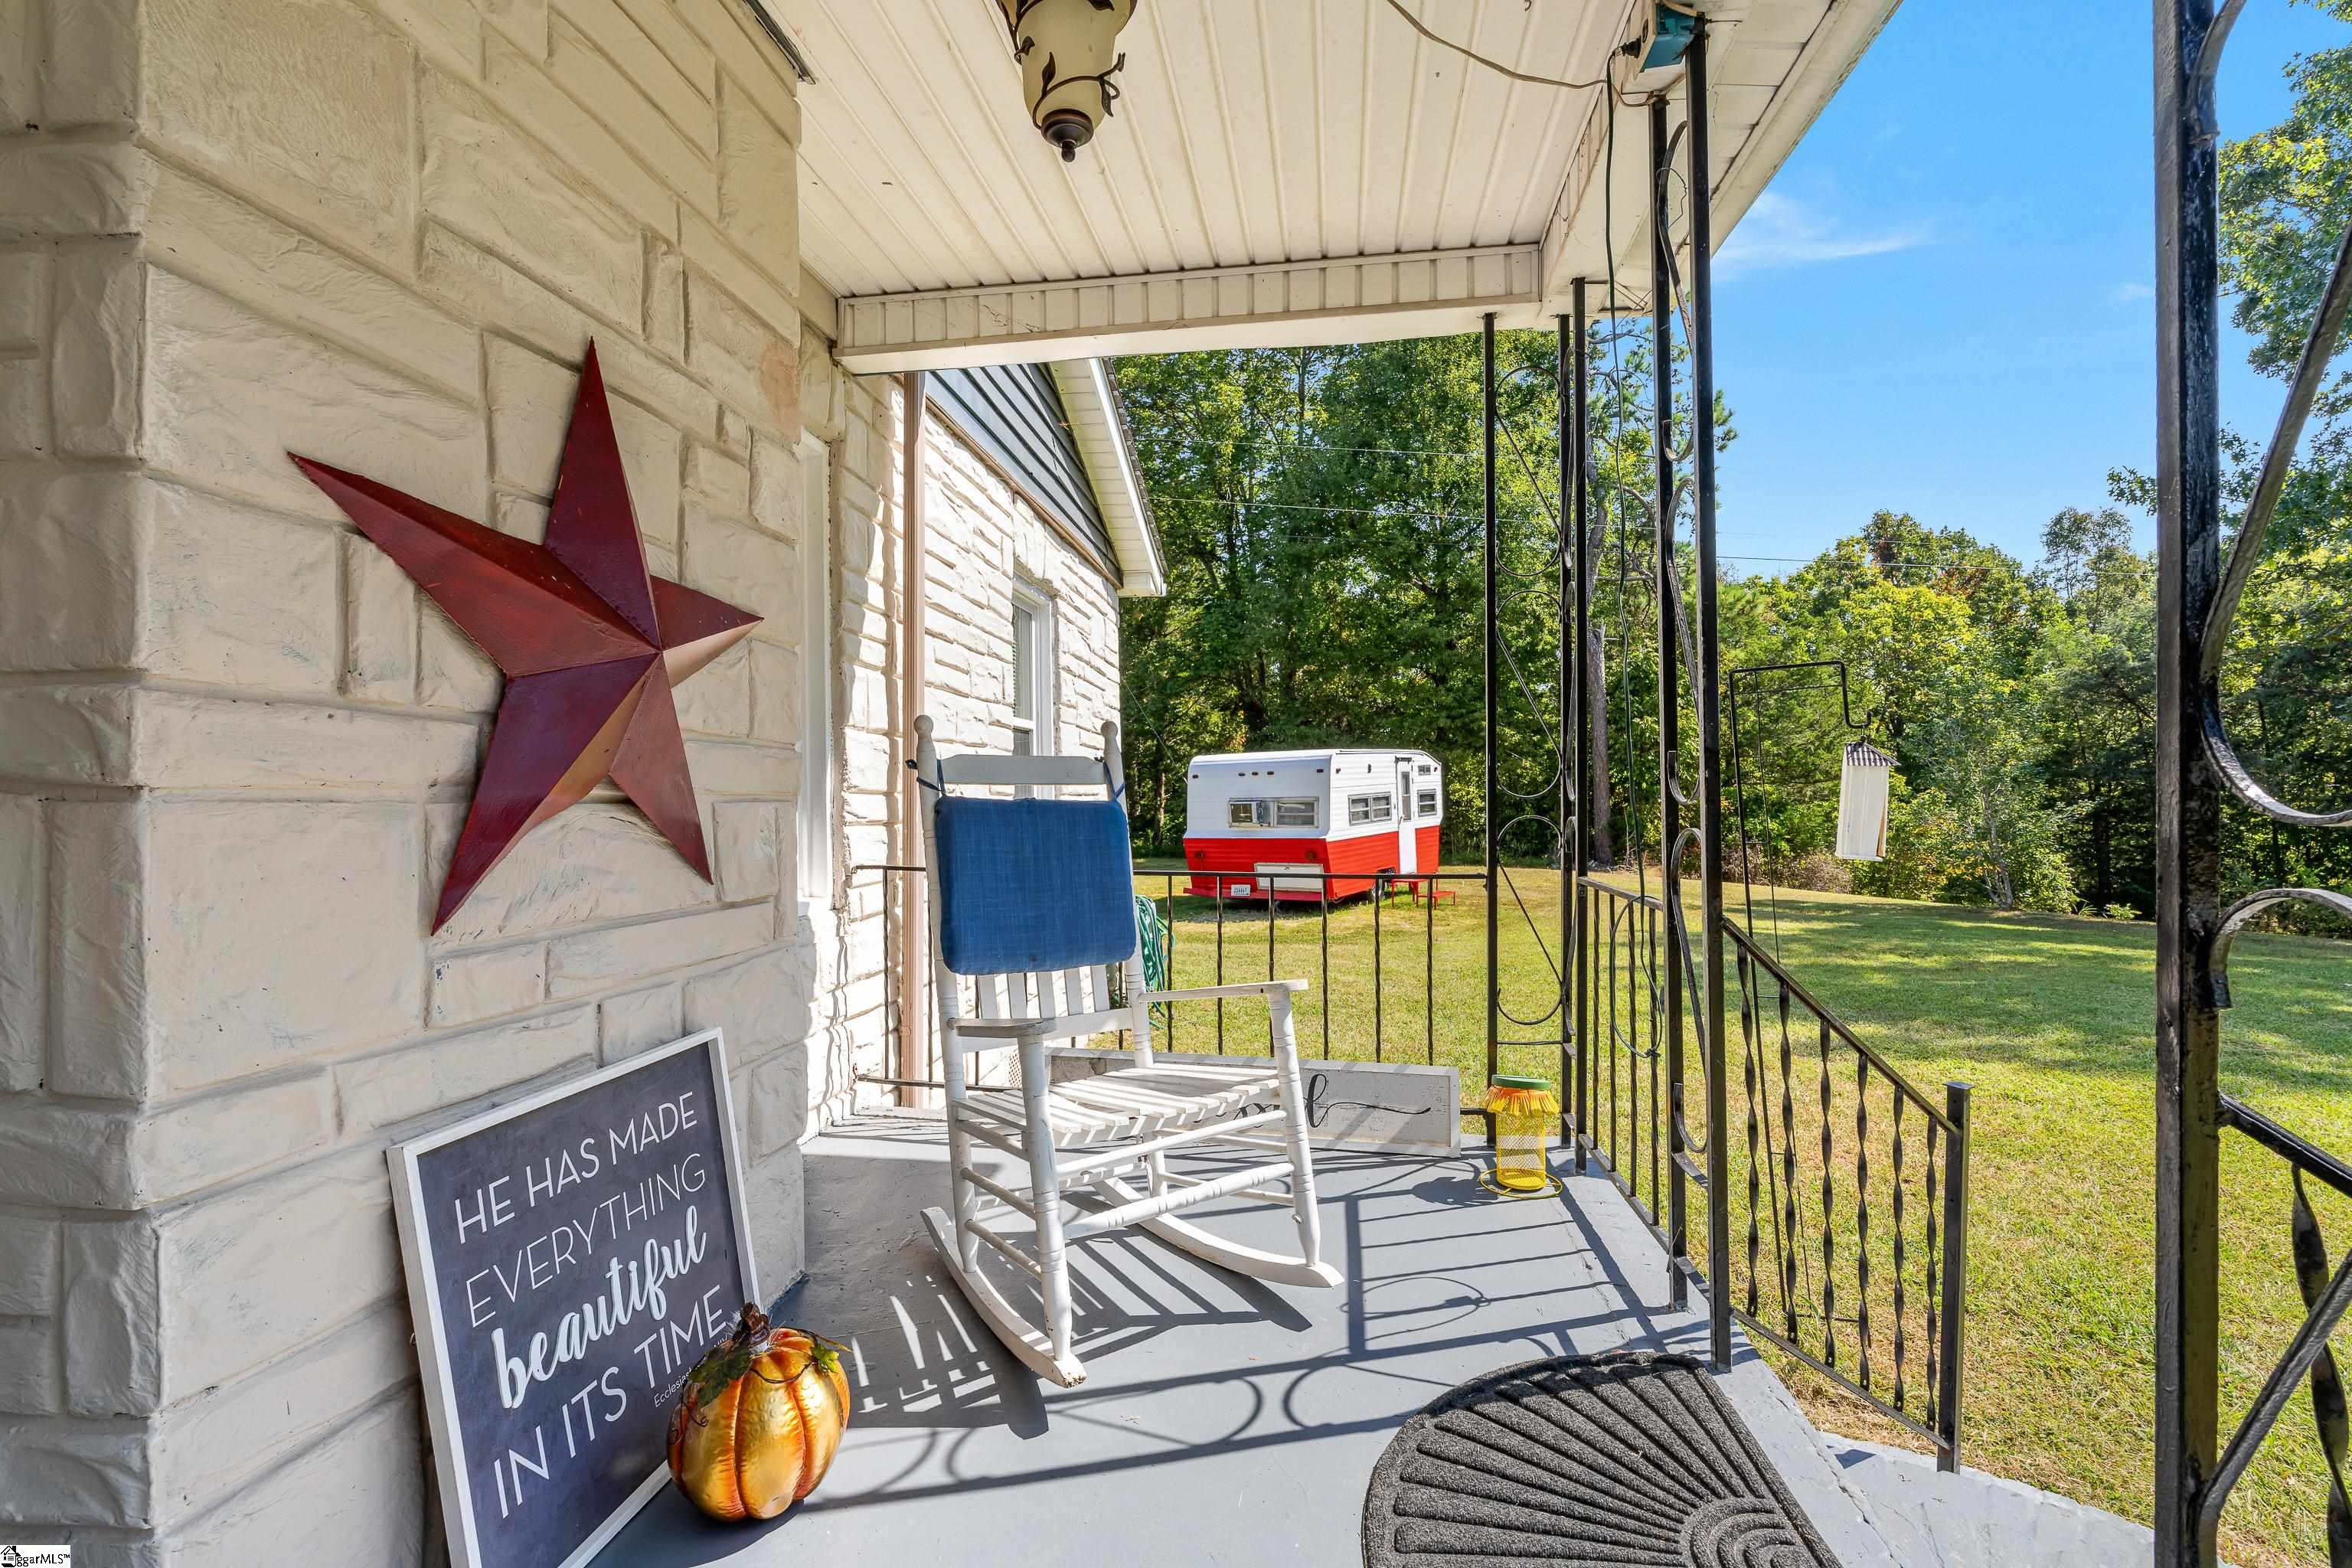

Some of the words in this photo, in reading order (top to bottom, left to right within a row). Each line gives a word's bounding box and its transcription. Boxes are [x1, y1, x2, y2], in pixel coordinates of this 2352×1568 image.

[454, 1175, 515, 1244] HE
[526, 1138, 599, 1207] HAS
[609, 1091, 697, 1166] MADE
[466, 1153, 706, 1328] EVERYTHING
[491, 1205, 707, 1410] beautiful
[494, 1425, 550, 1519] IN
[561, 1366, 627, 1459] ITS
[633, 1284, 727, 1389] TIME
